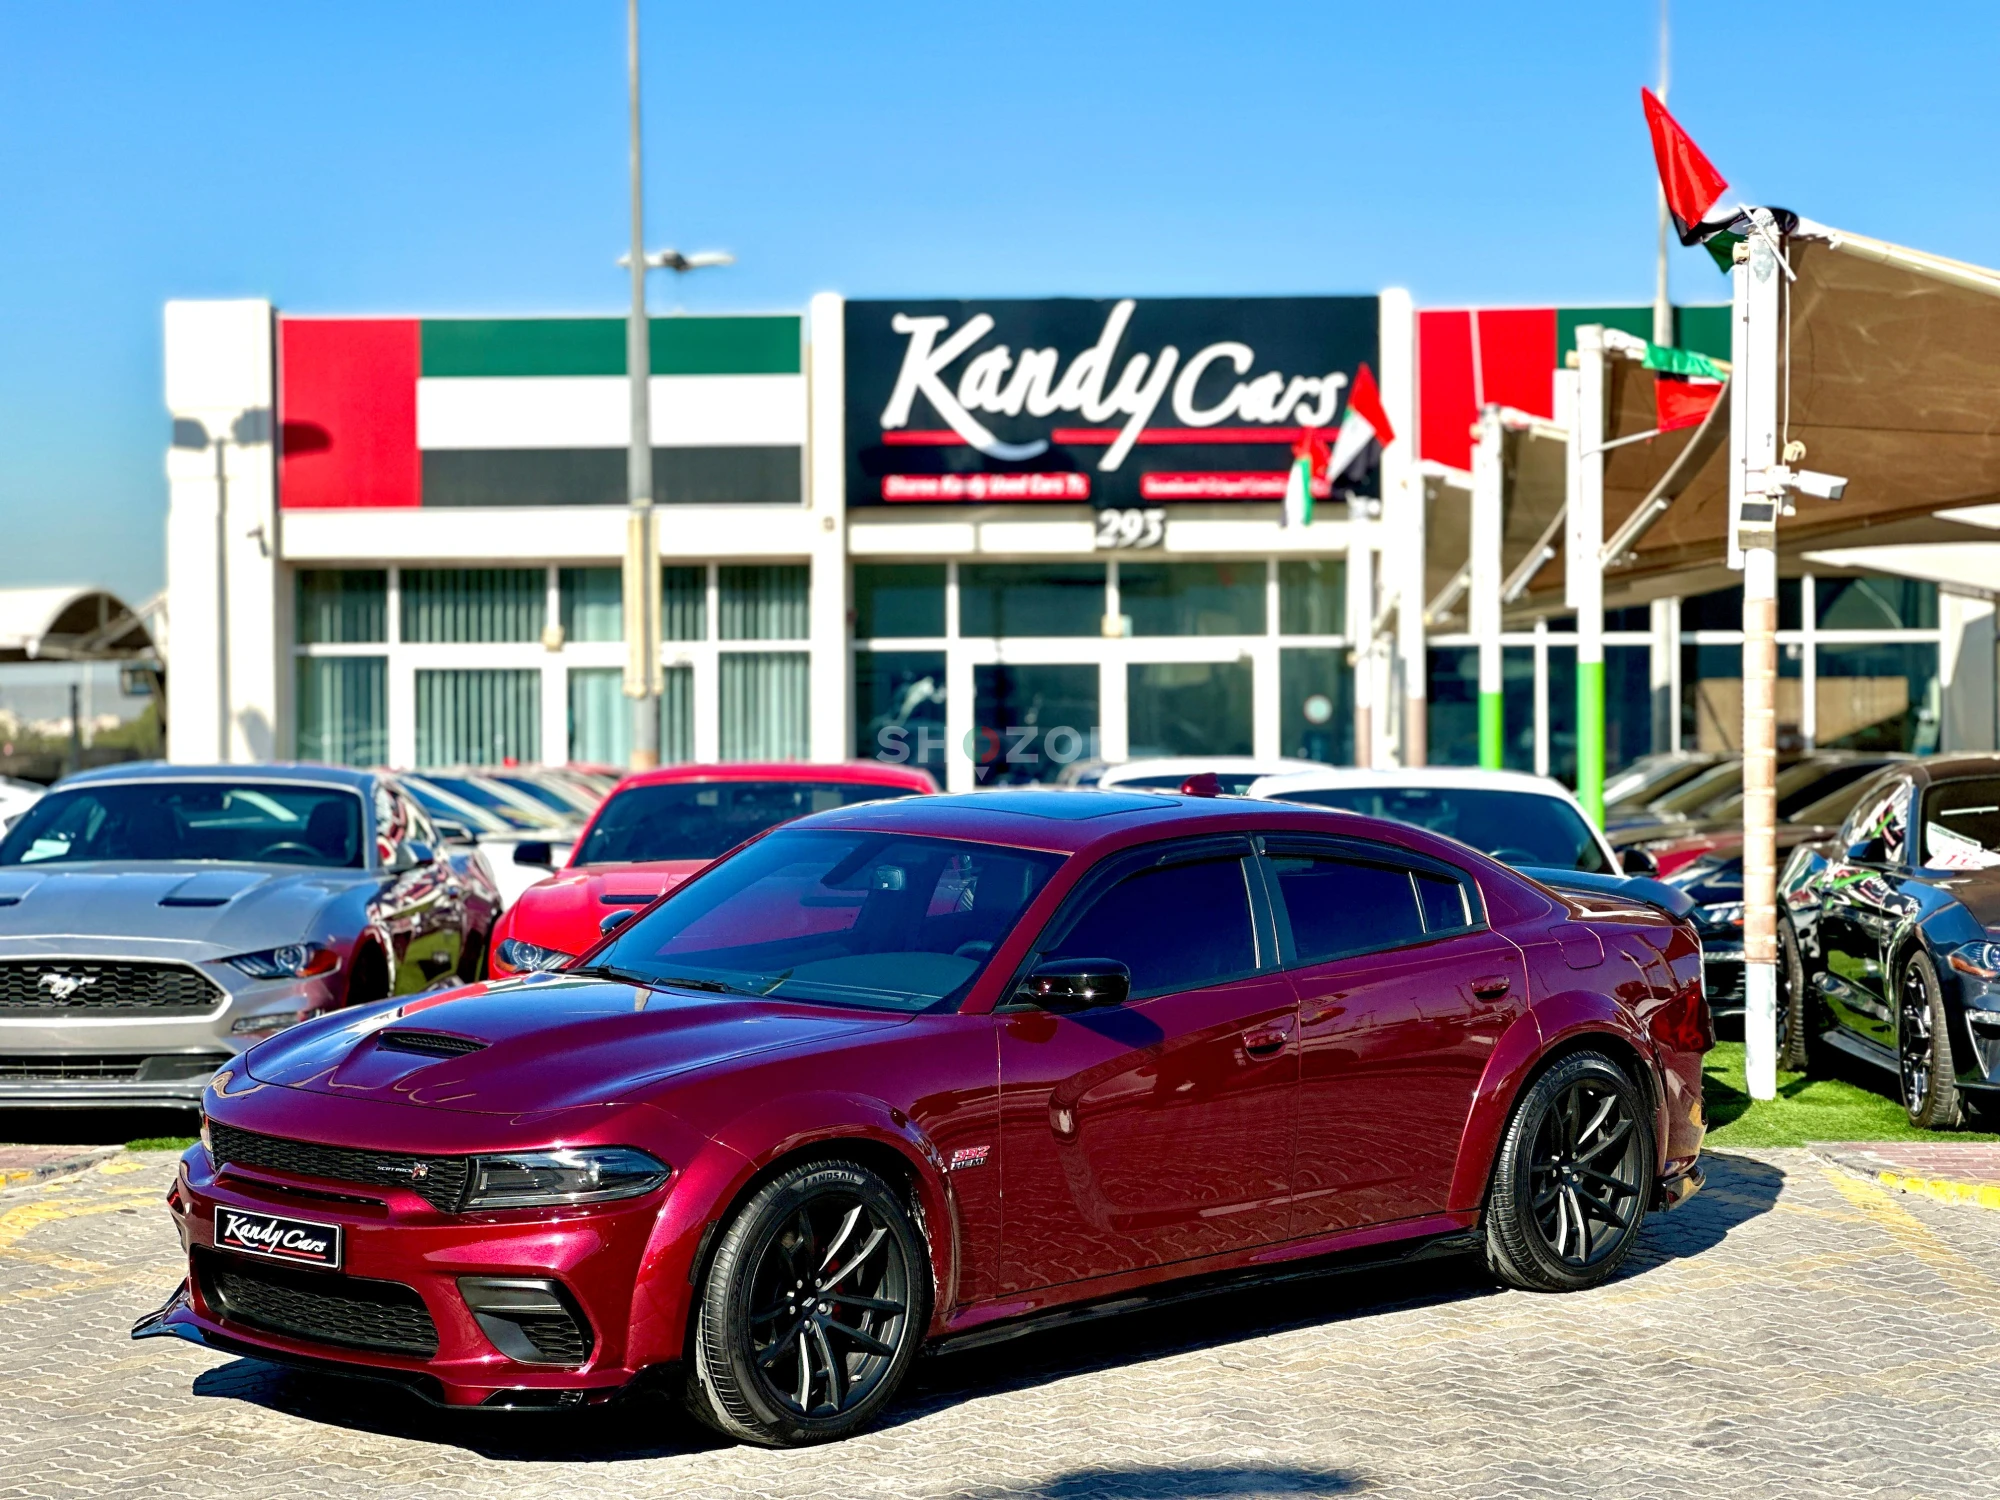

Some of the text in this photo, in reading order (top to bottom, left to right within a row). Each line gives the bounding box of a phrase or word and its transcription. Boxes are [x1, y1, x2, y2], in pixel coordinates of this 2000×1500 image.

[881, 299, 1349, 471] Kandy Cars
[952, 1145, 991, 1163] 392
[224, 1213, 327, 1254] Kandy Cars
